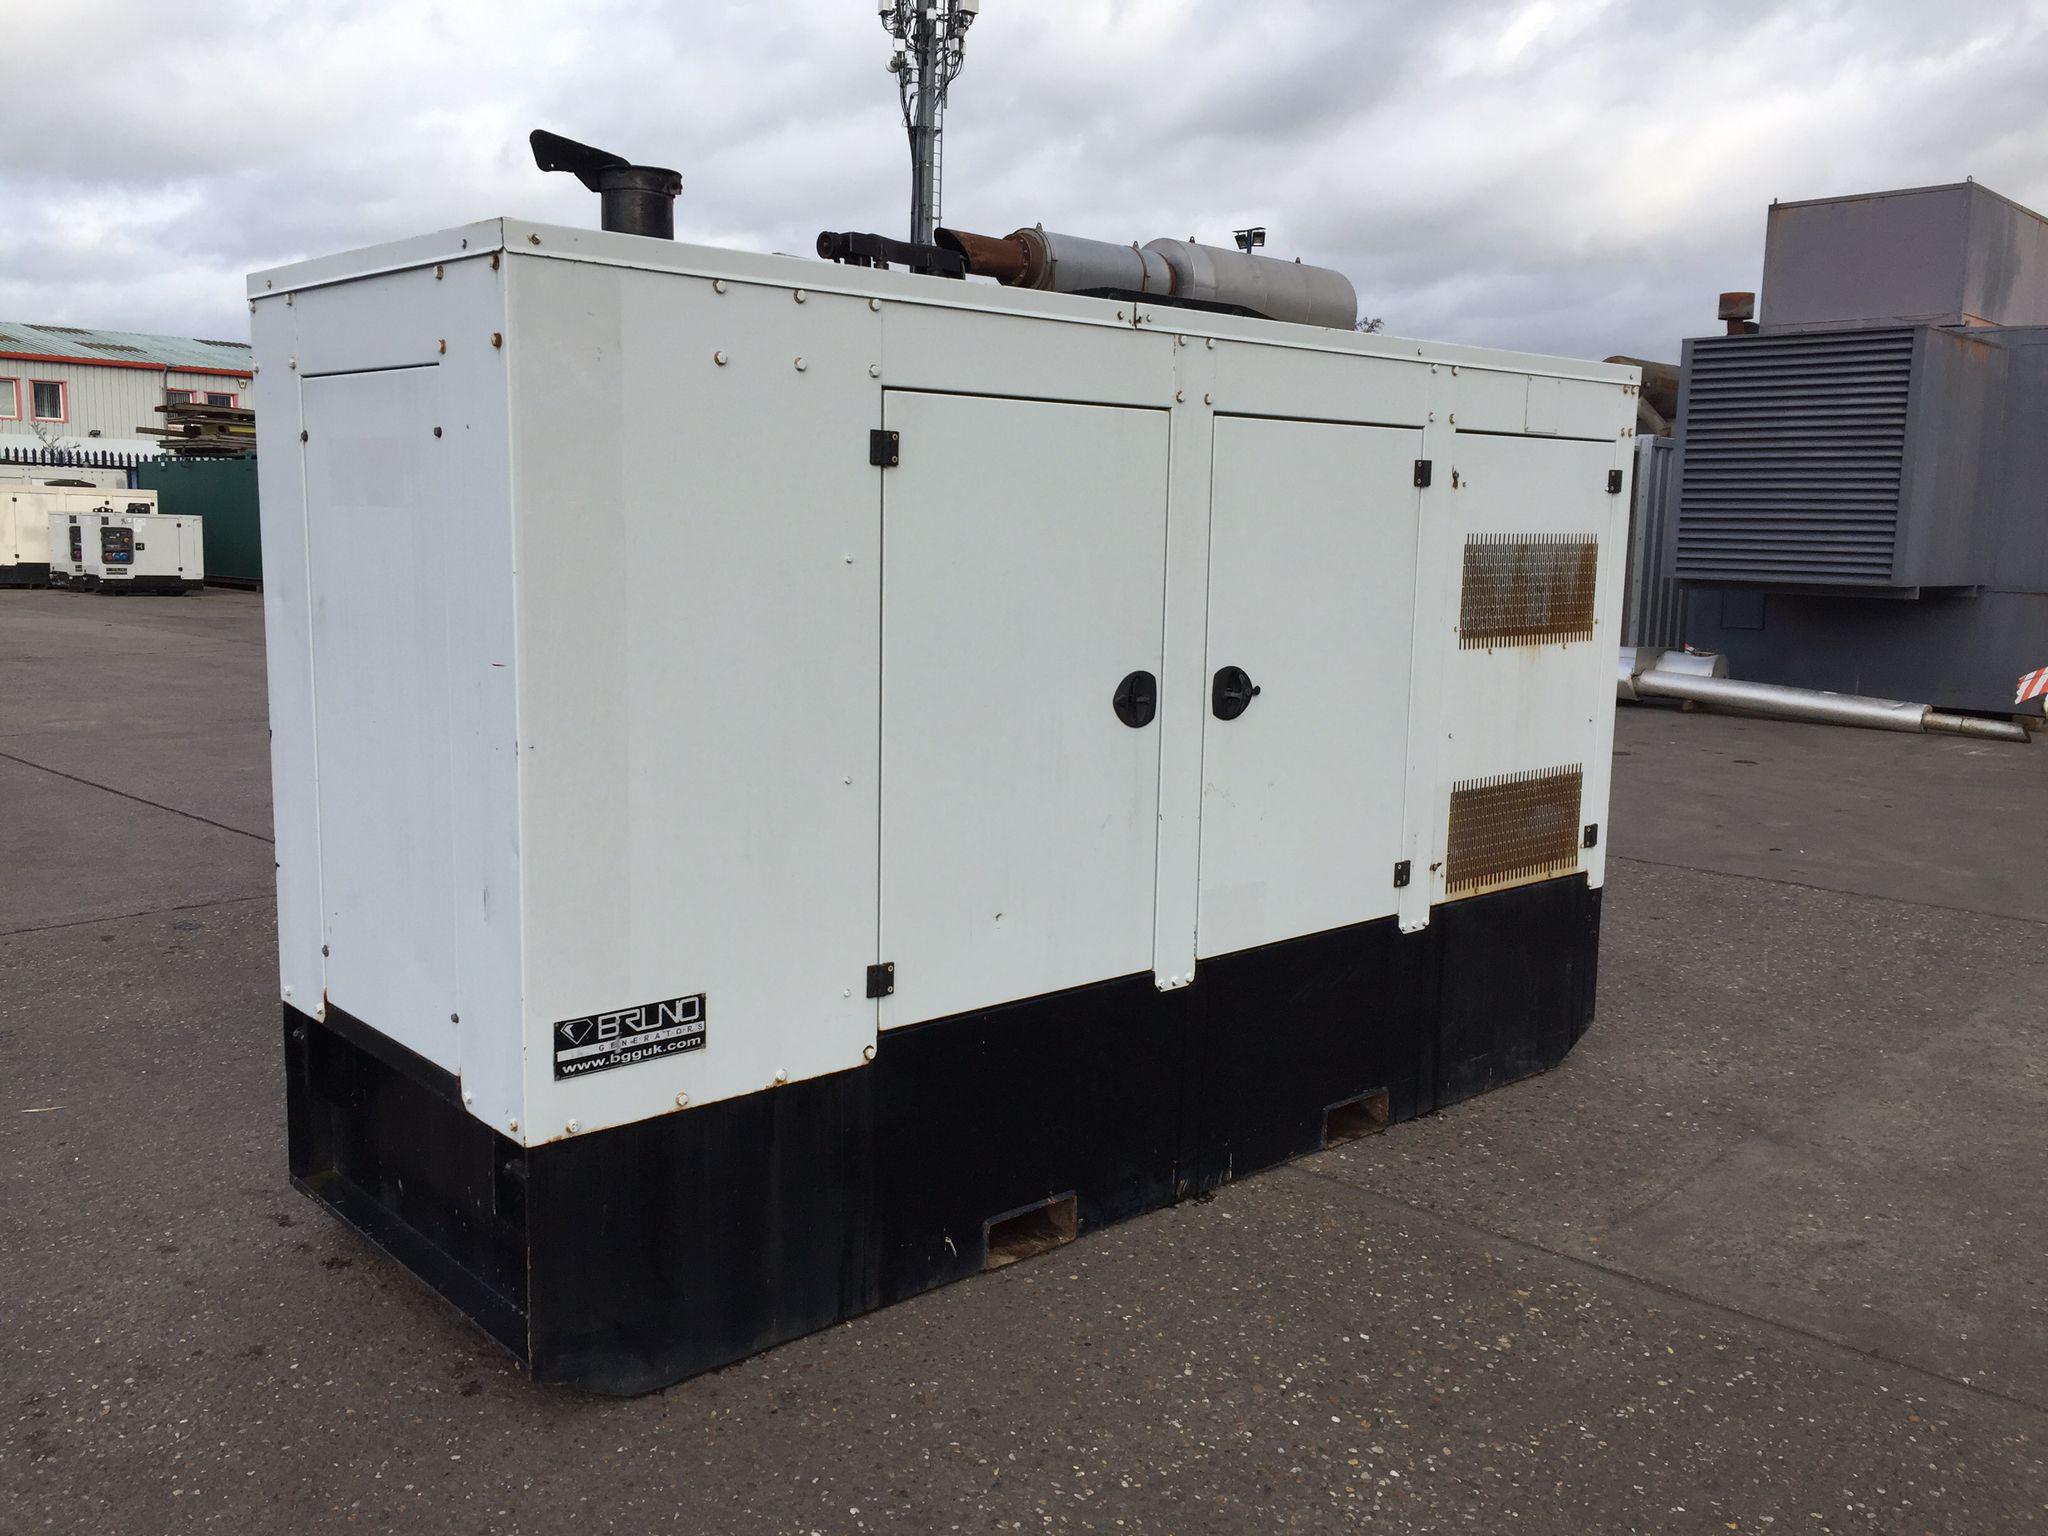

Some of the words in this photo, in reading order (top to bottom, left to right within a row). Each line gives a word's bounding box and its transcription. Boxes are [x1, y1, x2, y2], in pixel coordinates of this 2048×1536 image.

[598, 996, 700, 1040] BRUNO
[562, 1036, 701, 1074] www.bgguk.com
[598, 1023, 703, 1052] GENERATORS
